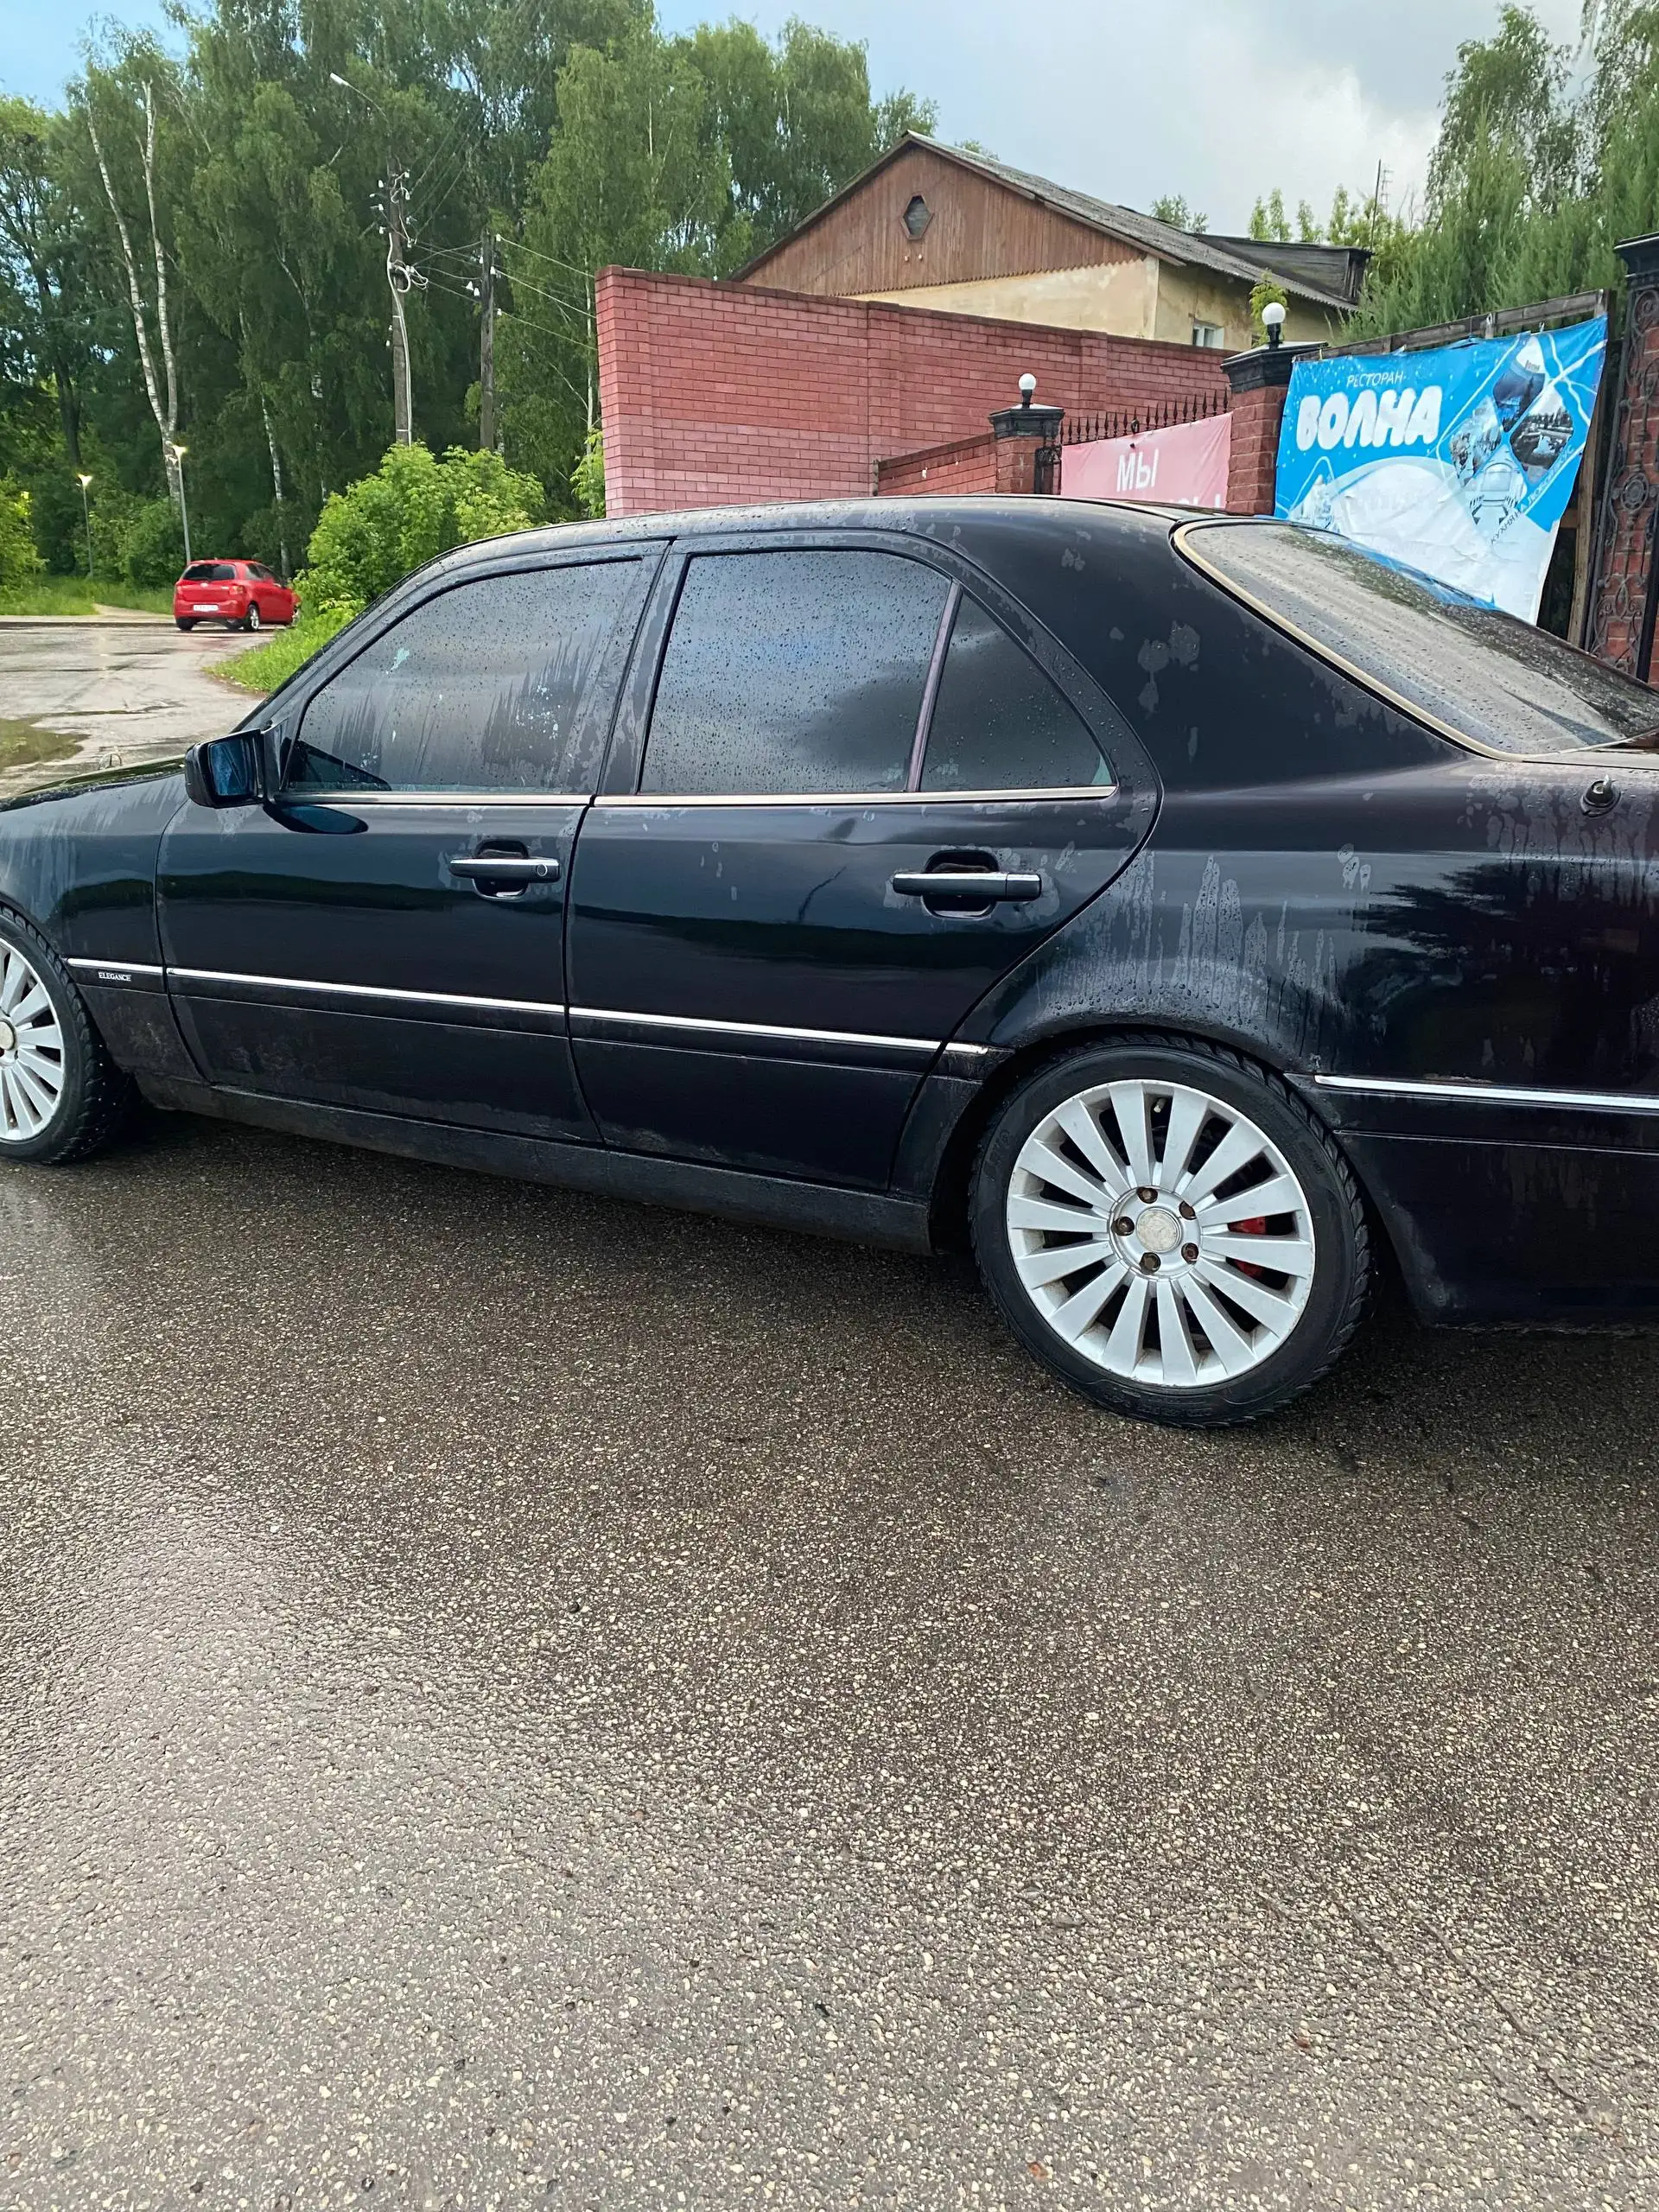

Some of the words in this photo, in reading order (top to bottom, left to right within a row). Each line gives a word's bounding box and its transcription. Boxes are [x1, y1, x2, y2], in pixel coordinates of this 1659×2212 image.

[1346, 371, 1404, 388] РЕСТОРАН
[1296, 385, 1442, 451] ВОЛНА
[1116, 448, 1159, 492] МЫ
[98, 971, 131, 982] ELEGANCE
